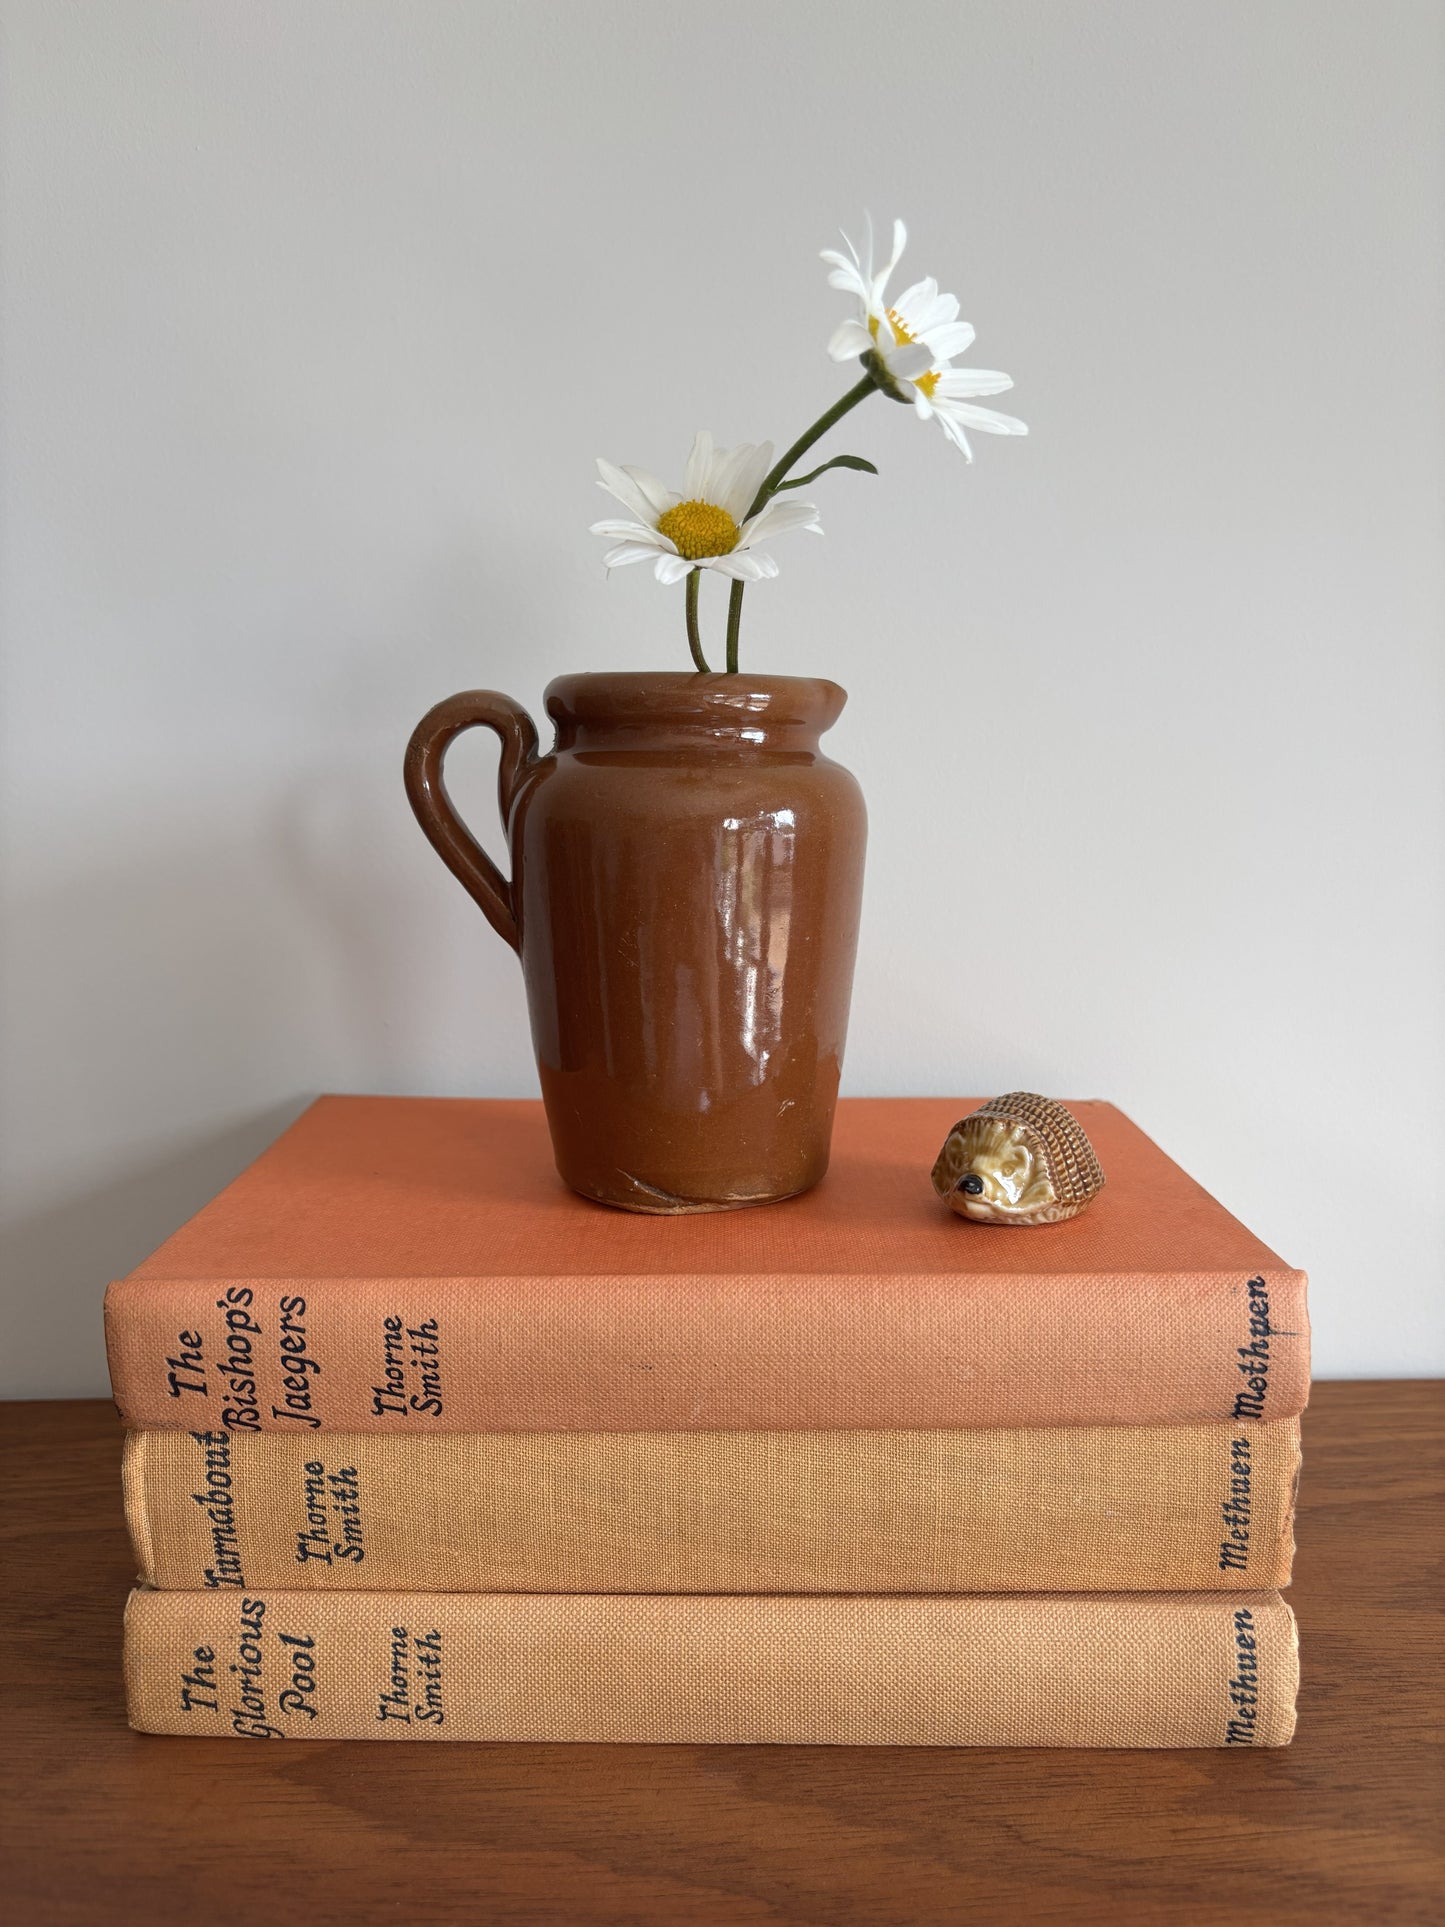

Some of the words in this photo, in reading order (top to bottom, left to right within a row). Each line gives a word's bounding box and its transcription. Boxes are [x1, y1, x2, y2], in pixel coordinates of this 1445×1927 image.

[166, 1329, 208, 1398] The
[216, 1286, 263, 1432] Bishop's
[271, 1295, 322, 1430] Jaegers
[370, 1314, 408, 1417] Thorne
[406, 1318, 443, 1417] Smith
[1231, 1275, 1270, 1420] Methuen
[190, 1430, 246, 1590] Turnabout
[296, 1460, 333, 1566] Thorne
[327, 1465, 365, 1563] Smith
[1218, 1437, 1252, 1571] Methuen
[180, 1645, 219, 1714] The
[229, 1597, 285, 1740] Glorious
[278, 1632, 318, 1720] Pool
[376, 1625, 411, 1724] Thorne
[413, 1628, 445, 1726] Smith
[1225, 1607, 1258, 1745] Methuen
